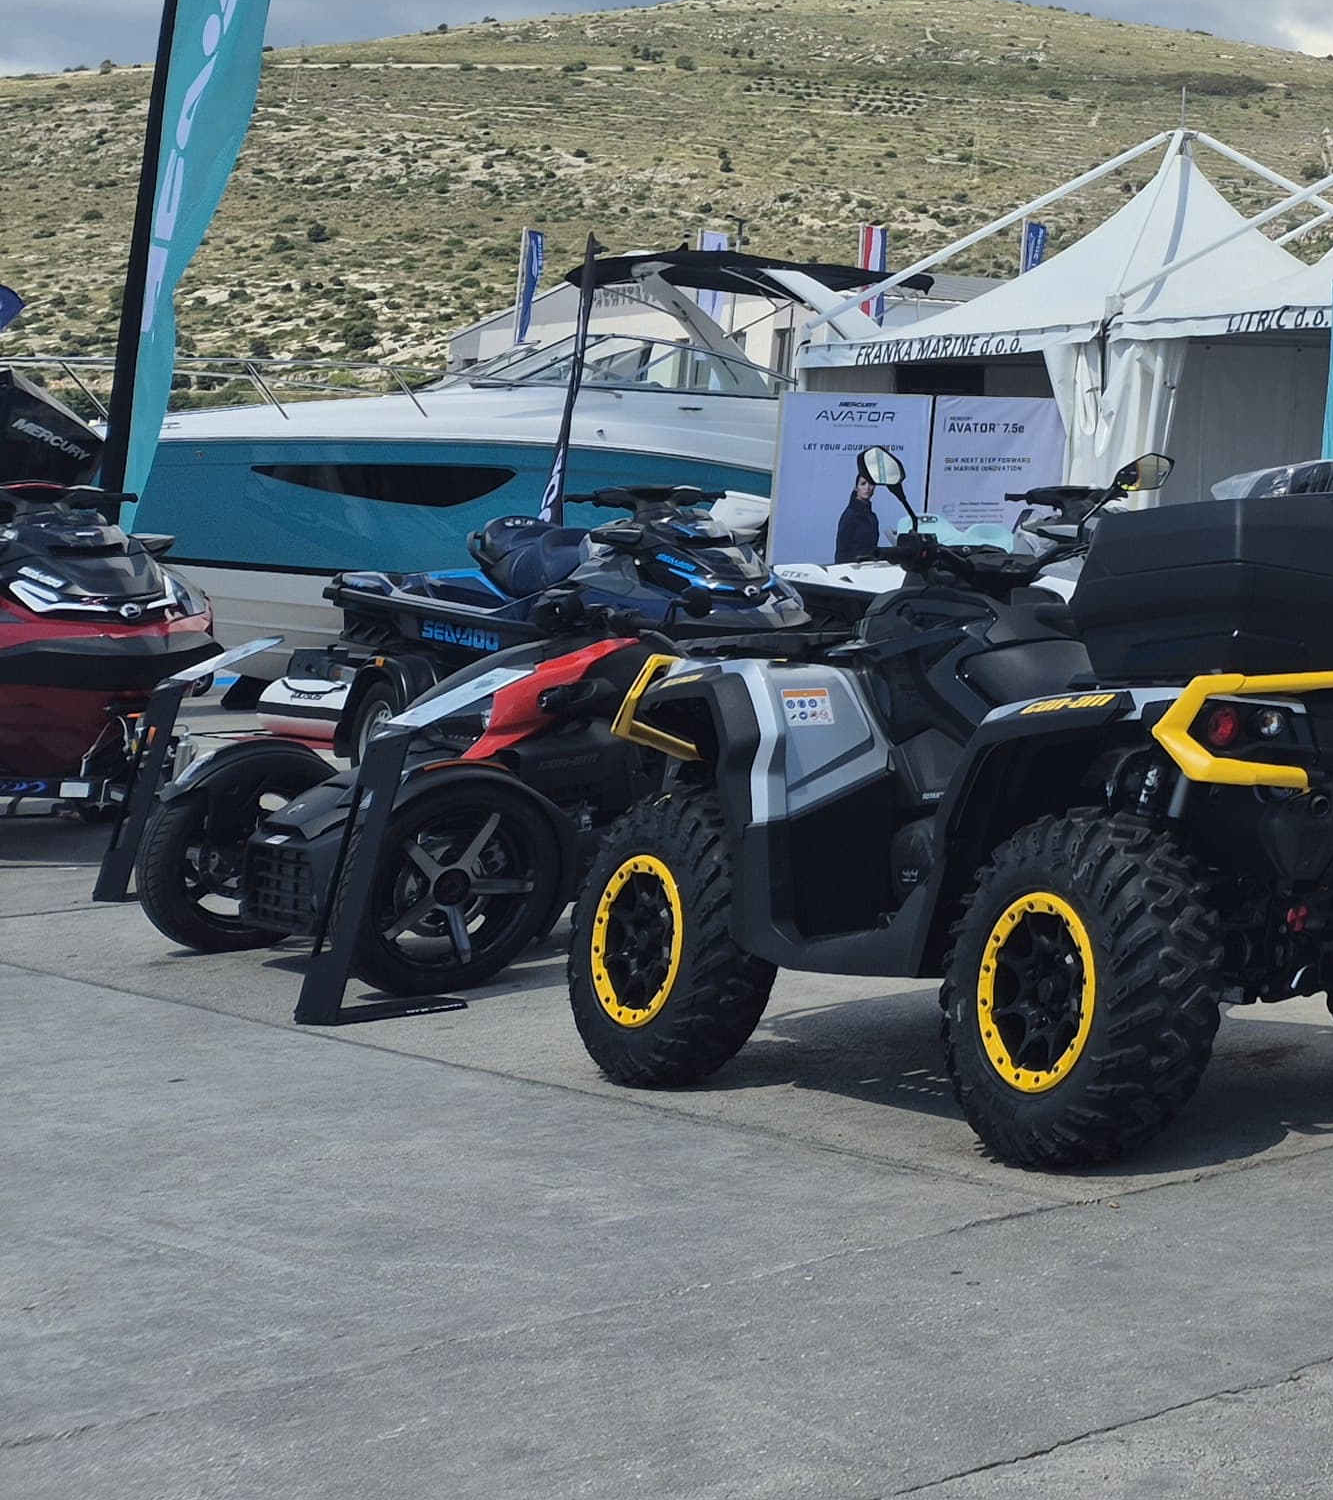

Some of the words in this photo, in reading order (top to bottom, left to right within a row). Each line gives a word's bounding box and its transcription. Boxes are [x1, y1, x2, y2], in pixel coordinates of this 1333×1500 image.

[855, 341, 912, 366] FRANKA
[913, 336, 977, 360] MARINE
[979, 334, 1023, 355] d.o.o.
[815, 410, 896, 422] AVATOR
[948, 422, 996, 434] AVATOR
[11, 418, 92, 461] MERCURY
[803, 443, 817, 451] LET
